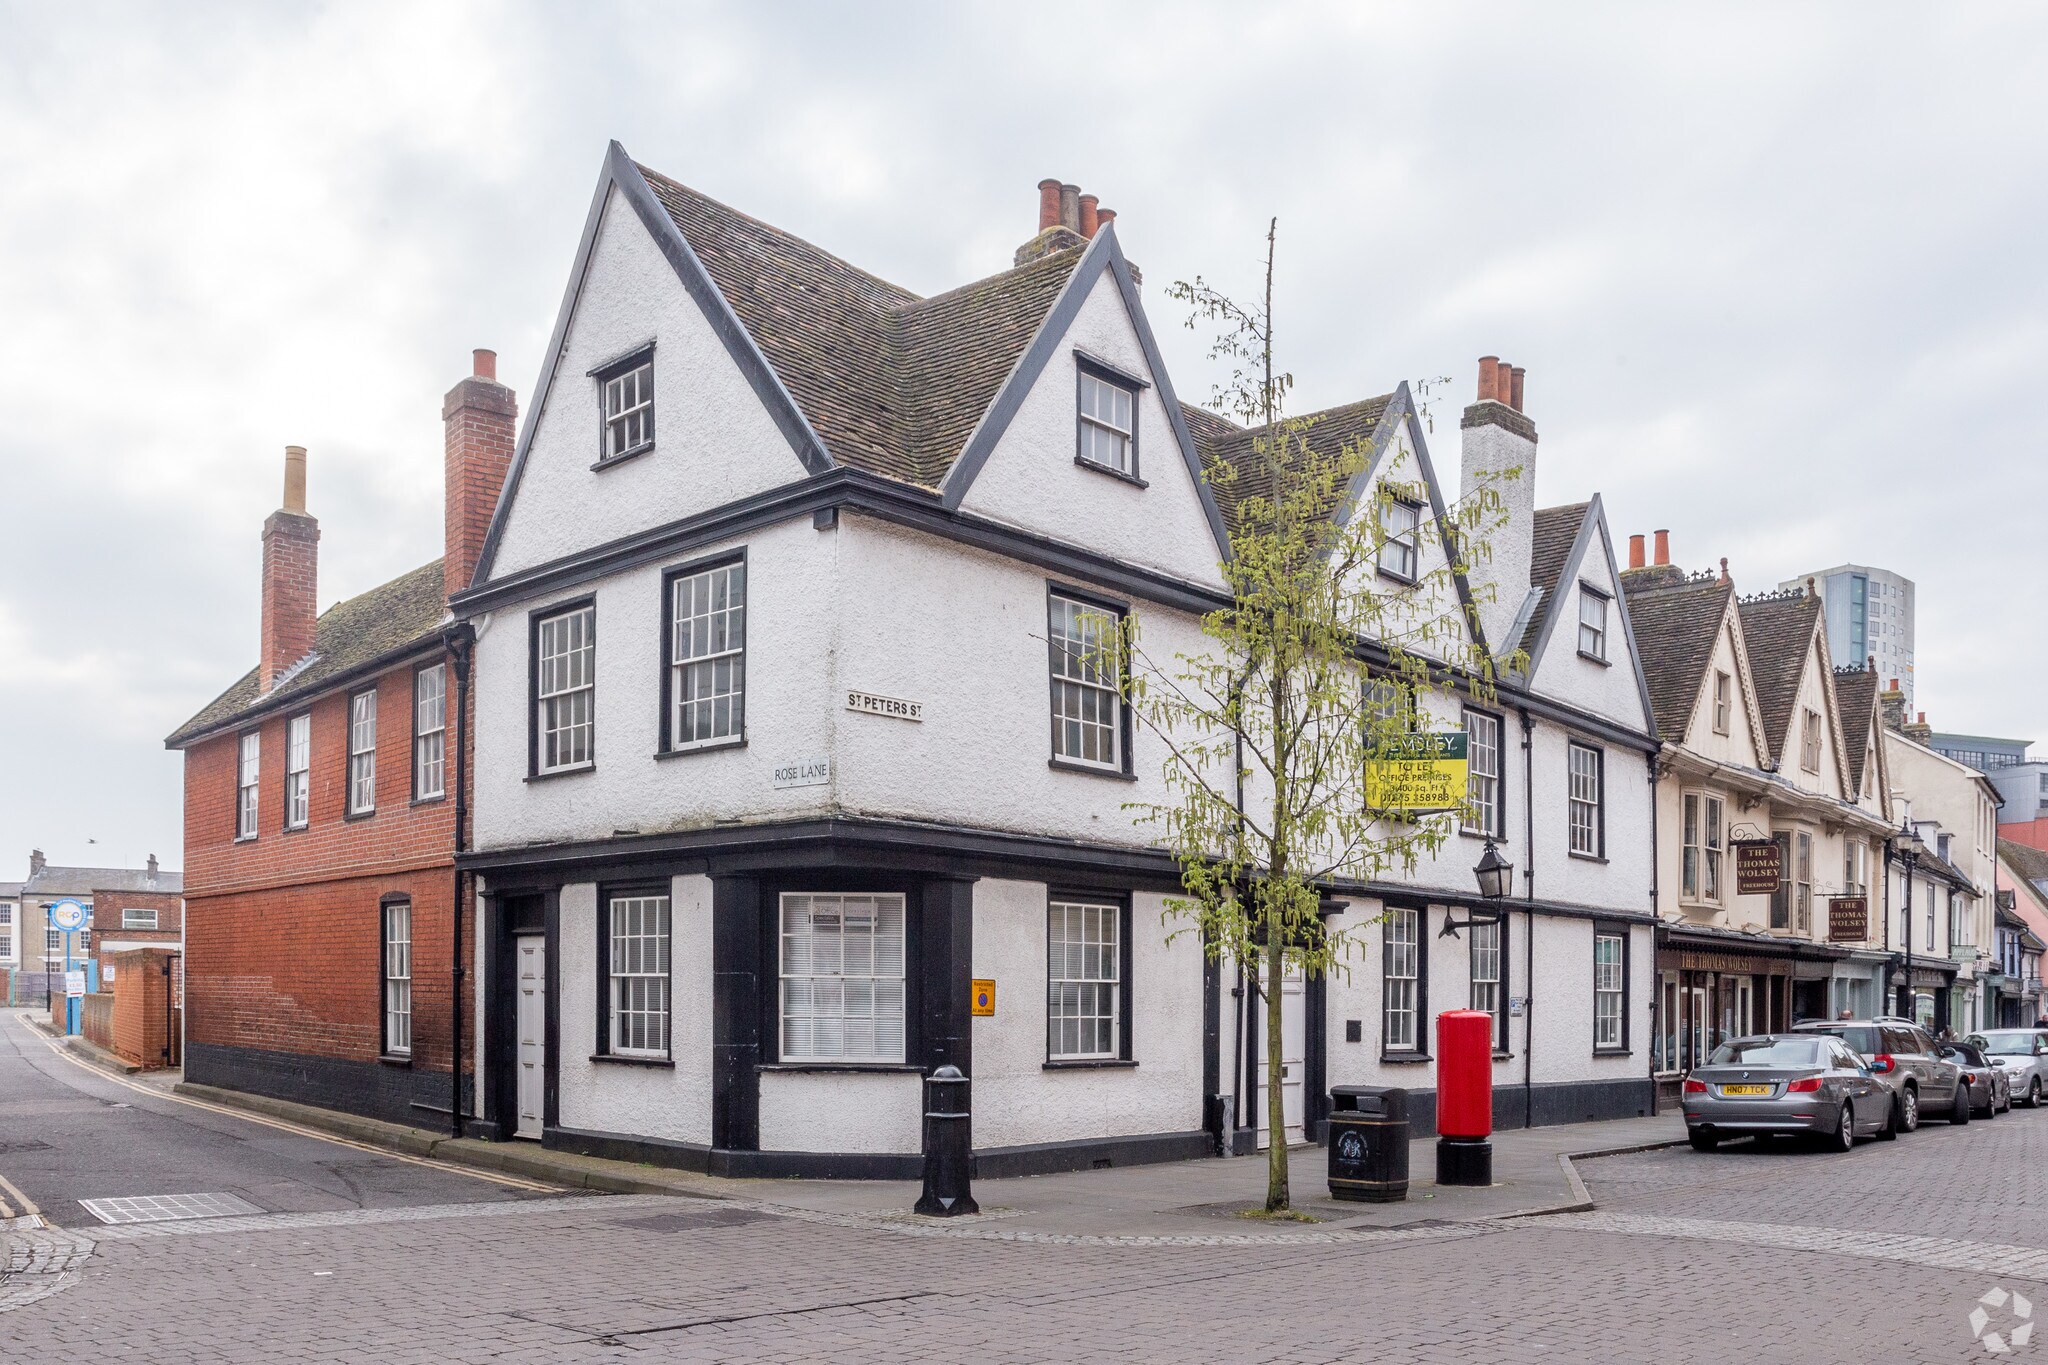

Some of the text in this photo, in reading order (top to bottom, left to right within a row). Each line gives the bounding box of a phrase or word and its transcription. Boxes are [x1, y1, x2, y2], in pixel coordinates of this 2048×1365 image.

[864, 696, 907, 714] PETERS
[1377, 736, 1455, 751] MSLEY
[1398, 761, 1433, 771] TO LET
[775, 764, 827, 781] ROSE LANE
[1747, 848, 1769, 857] THE
[1737, 859, 1780, 868] THOMAS
[1737, 868, 1780, 877] WOLSEY
[1830, 919, 1867, 927] WOLSEY
[1681, 954, 1751, 971] THE THOMAS WOLSEY
[1726, 1086, 1766, 1094] HN07 TCK
